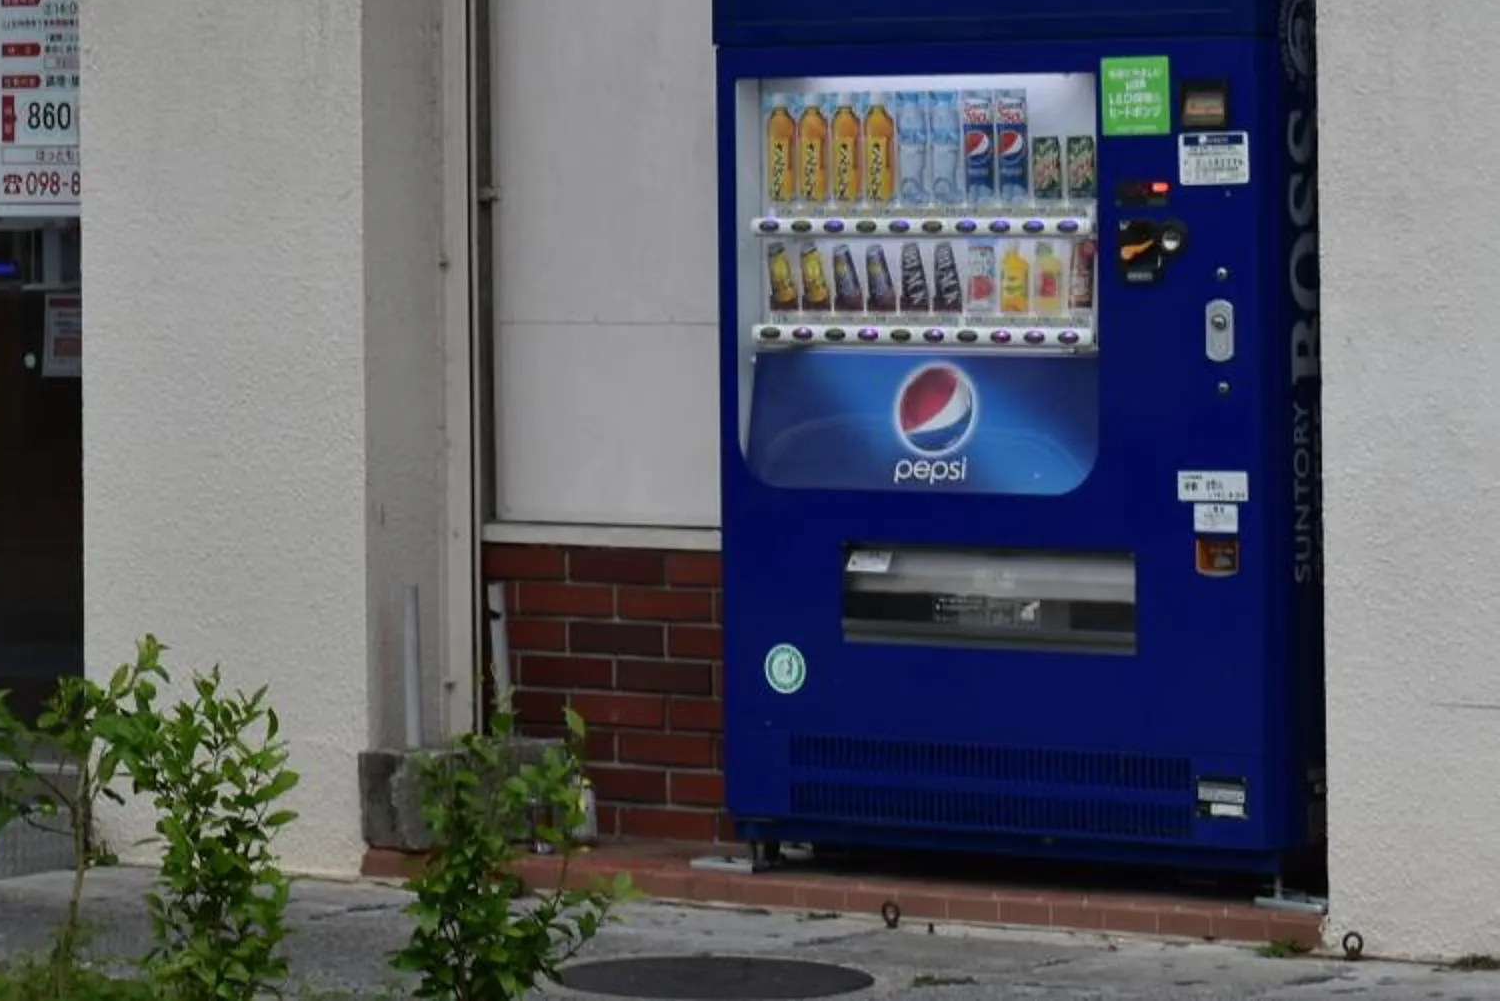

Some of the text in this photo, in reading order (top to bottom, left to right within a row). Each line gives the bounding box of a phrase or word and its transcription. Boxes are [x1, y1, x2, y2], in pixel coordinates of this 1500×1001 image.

[27, 101, 71, 131] 860
[893, 456, 968, 485] pepsi
[1292, 400, 1312, 585] SUNTORY
